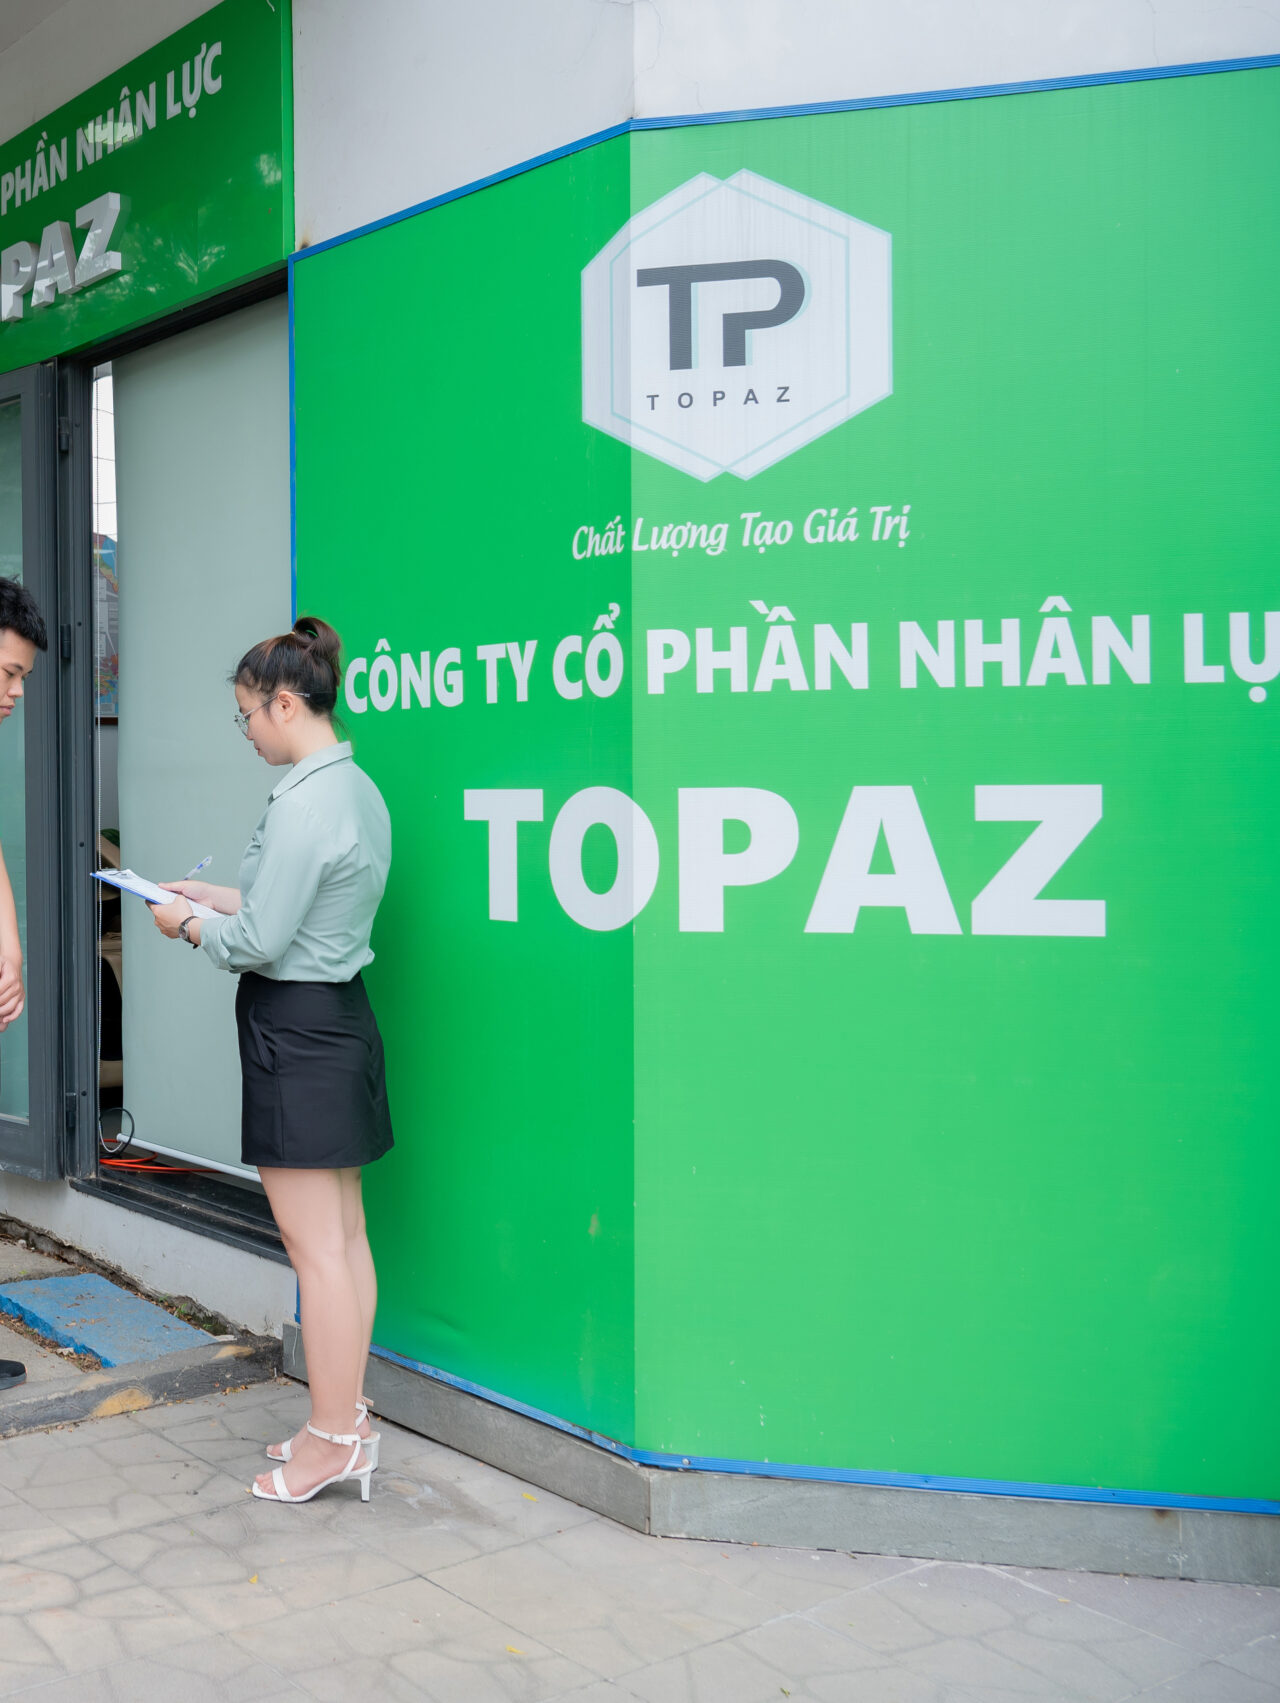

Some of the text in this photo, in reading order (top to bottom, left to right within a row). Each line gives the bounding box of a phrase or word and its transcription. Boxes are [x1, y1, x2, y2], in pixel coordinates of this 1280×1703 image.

[1, 131, 67, 216] PHẦN
[76, 82, 156, 172] NHÂN
[166, 41, 222, 120] LỰC
[637, 259, 806, 372] TP
[646, 386, 792, 411] TOPAZ
[572, 505, 912, 560] Chất Lượng Tạo Giá Trị
[344, 637, 463, 713] CÔNG
[477, 641, 536, 705] TY
[552, 602, 624, 700] CỔ
[647, 600, 869, 694] PHẦN
[899, 595, 1151, 687] NHÂN
[463, 784, 1107, 937] TOPAZ
